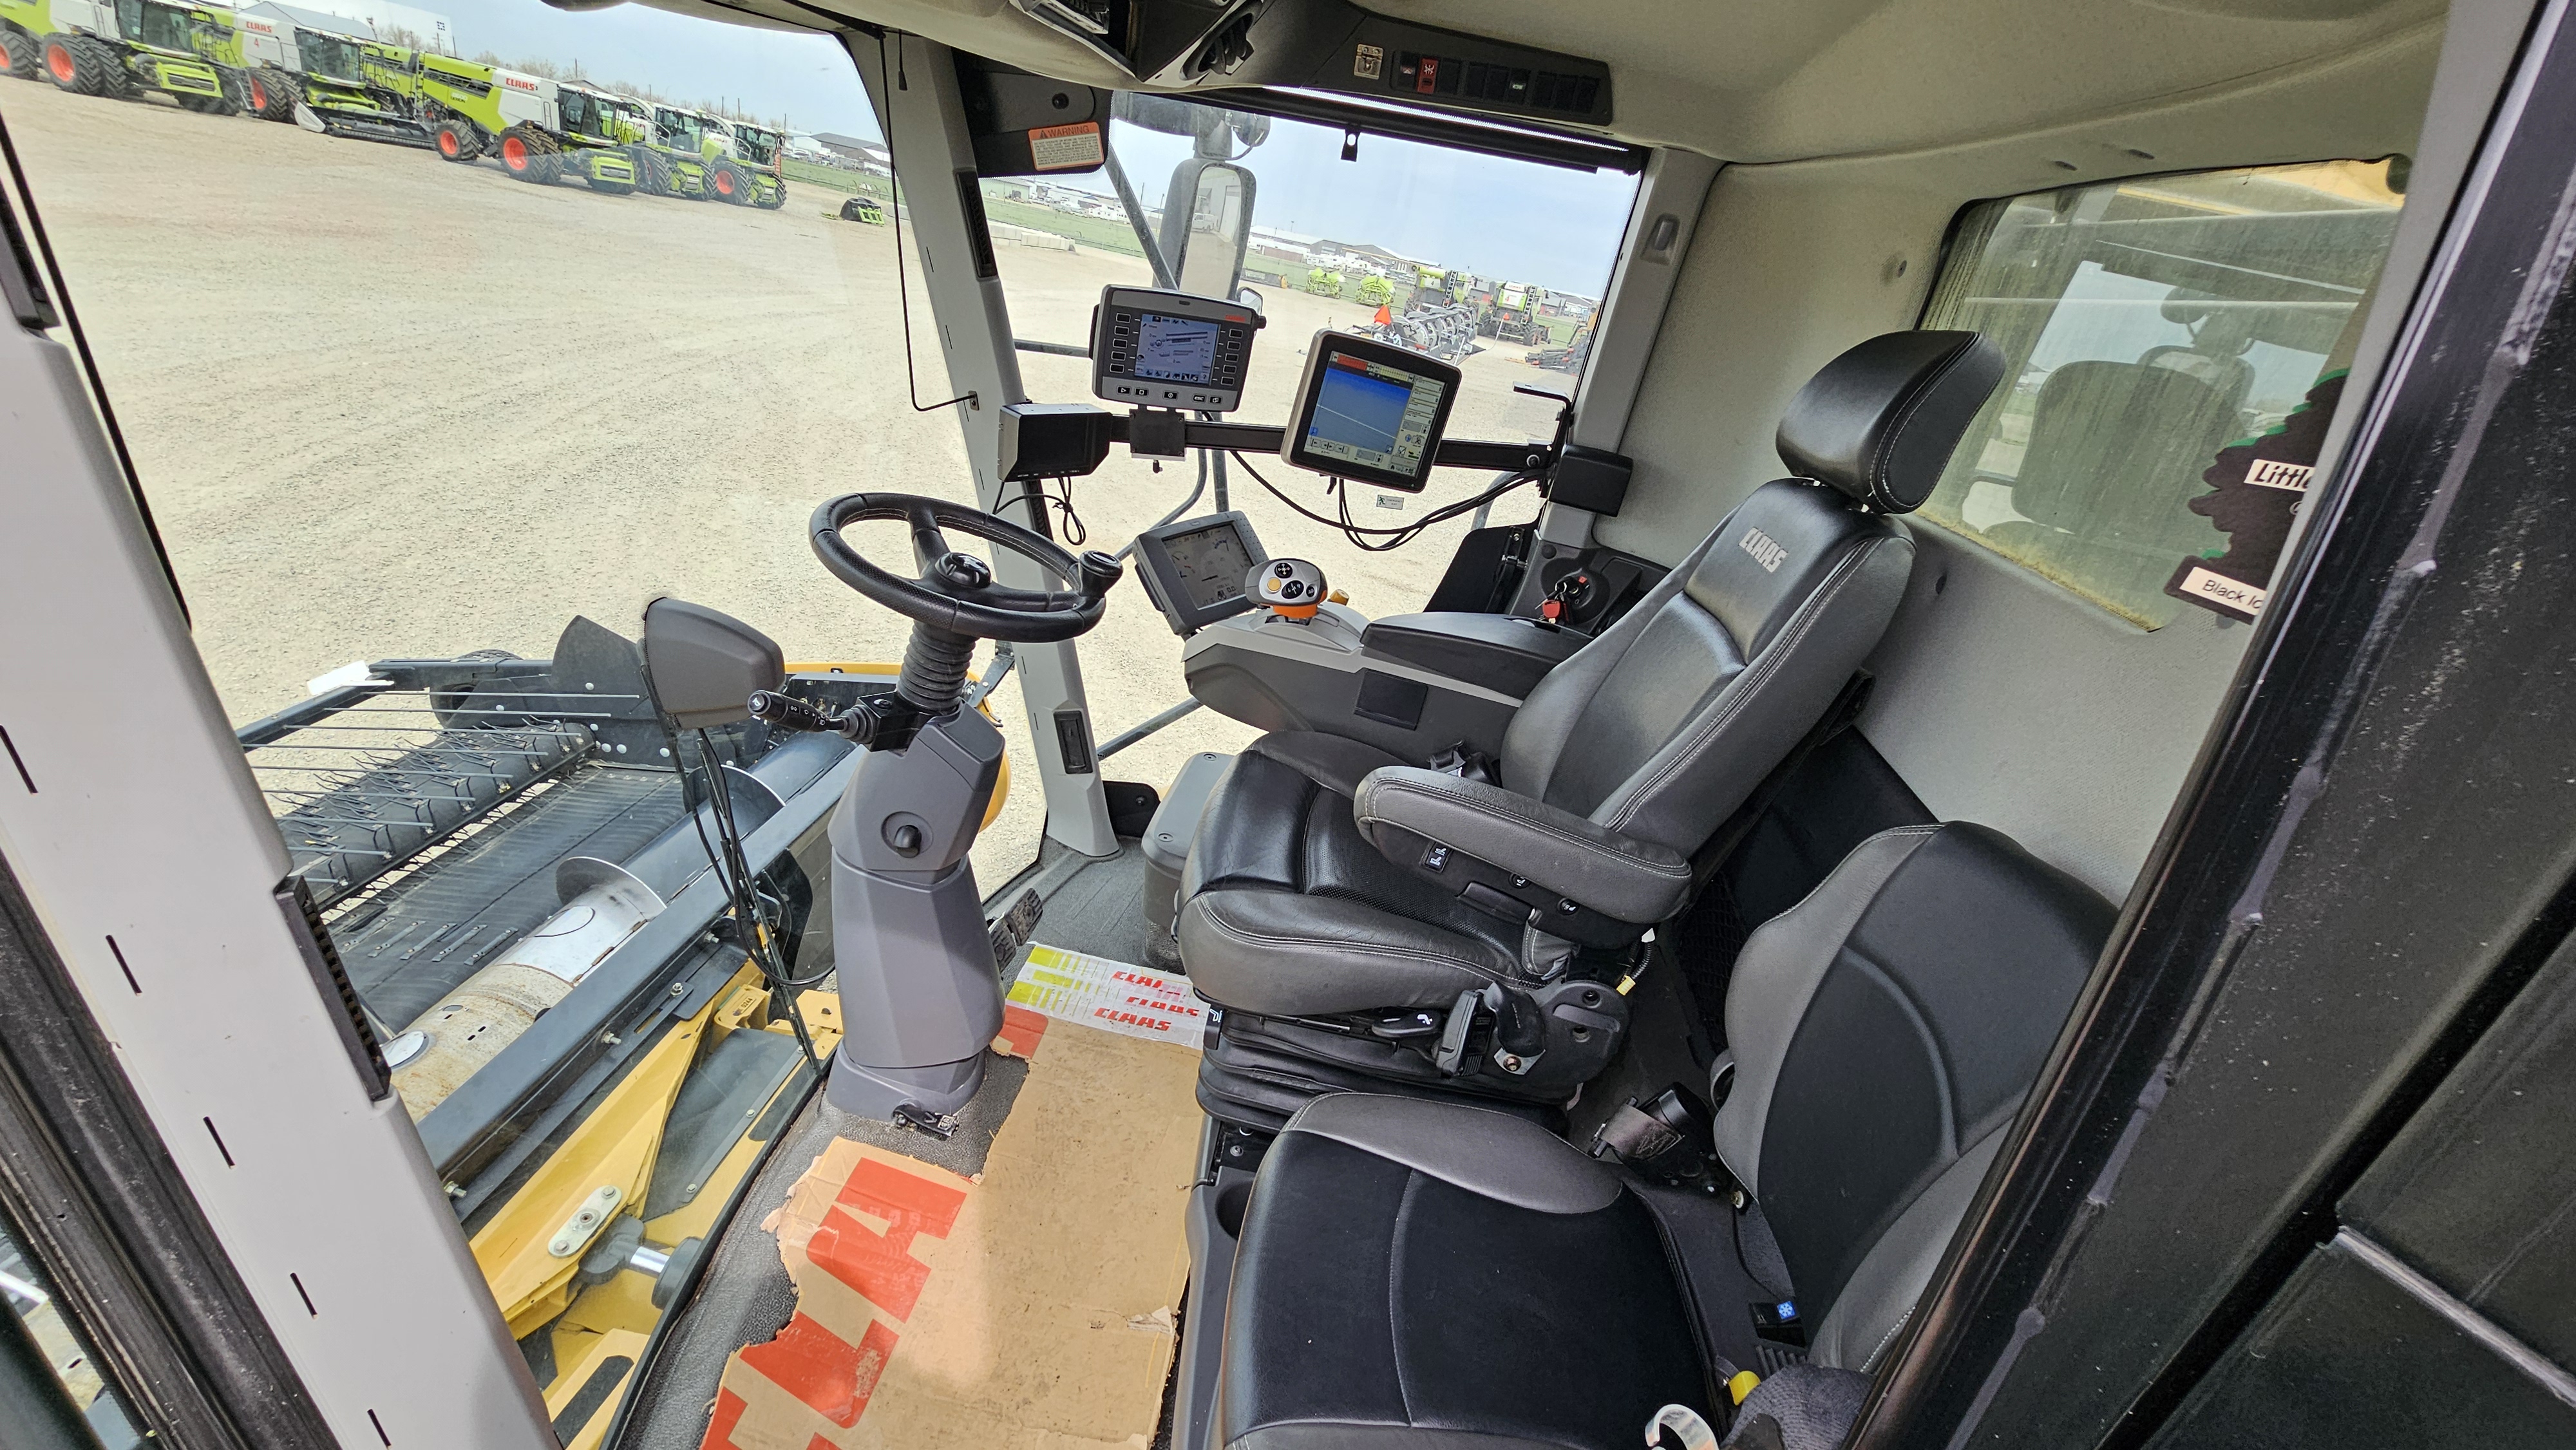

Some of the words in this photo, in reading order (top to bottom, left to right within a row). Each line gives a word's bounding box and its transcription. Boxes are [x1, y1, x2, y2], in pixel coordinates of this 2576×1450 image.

[246, 21, 272, 33] CLAAS
[506, 77, 535, 91] CLAAS
[1047, 125, 1090, 137] WARNING
[1738, 526, 1788, 573] CLAAS
[2202, 579, 2246, 603] Black
[1094, 1007, 1171, 1031] CLAAS
